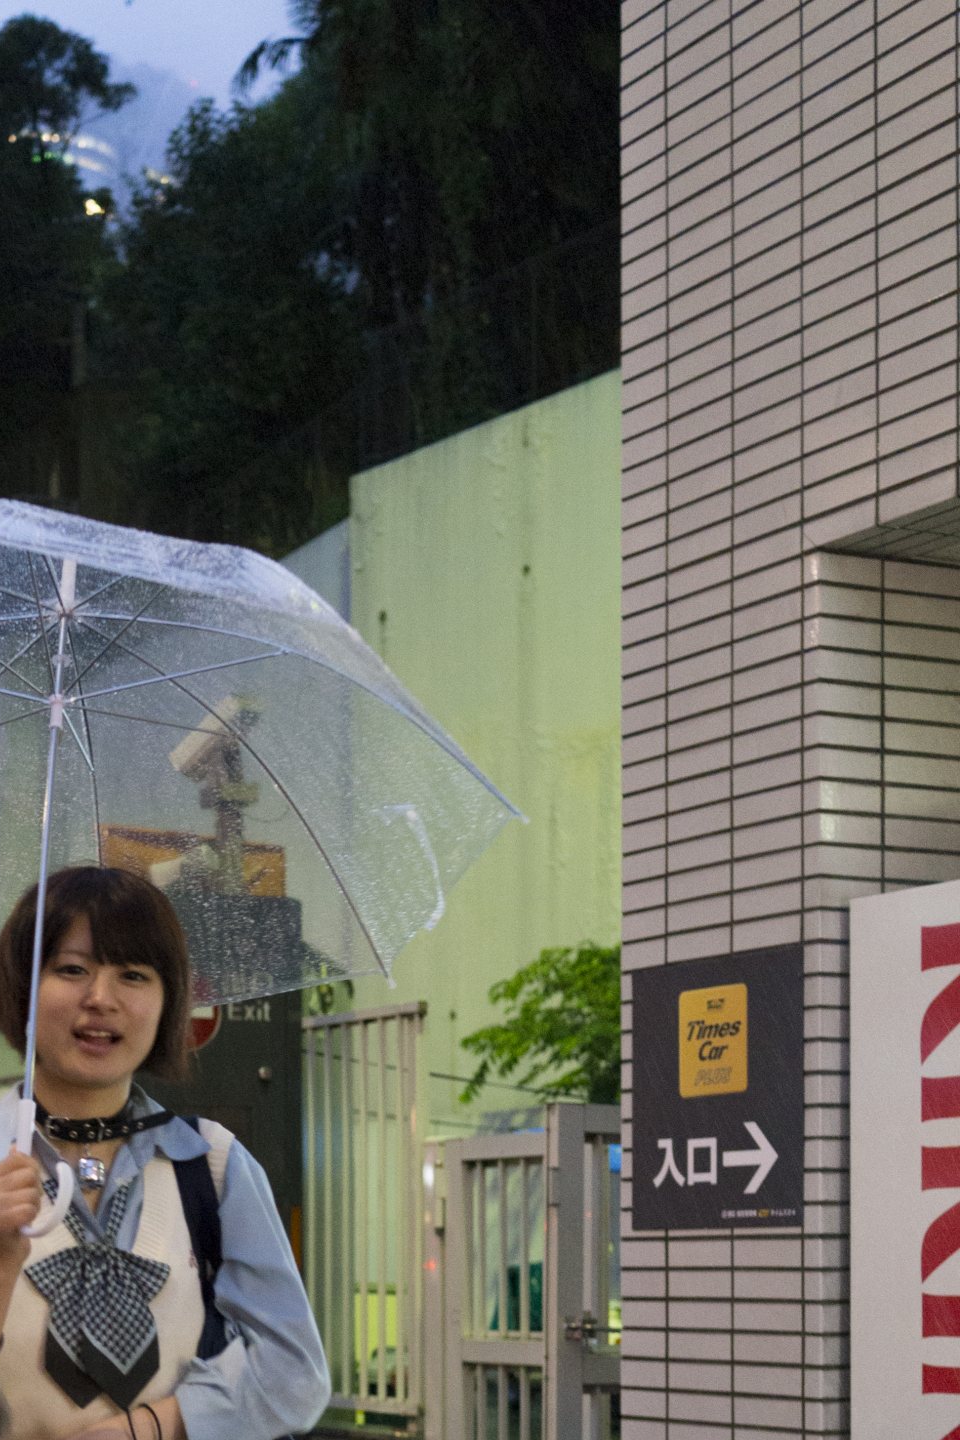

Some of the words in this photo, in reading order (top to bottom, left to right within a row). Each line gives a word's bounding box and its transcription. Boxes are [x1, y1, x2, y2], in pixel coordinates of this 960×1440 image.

[227, 1000, 271, 1022] Exit
[687, 1020, 741, 1041] Times
[698, 1041, 728, 1061] Car
[652, 1137, 717, 1188] 入口
